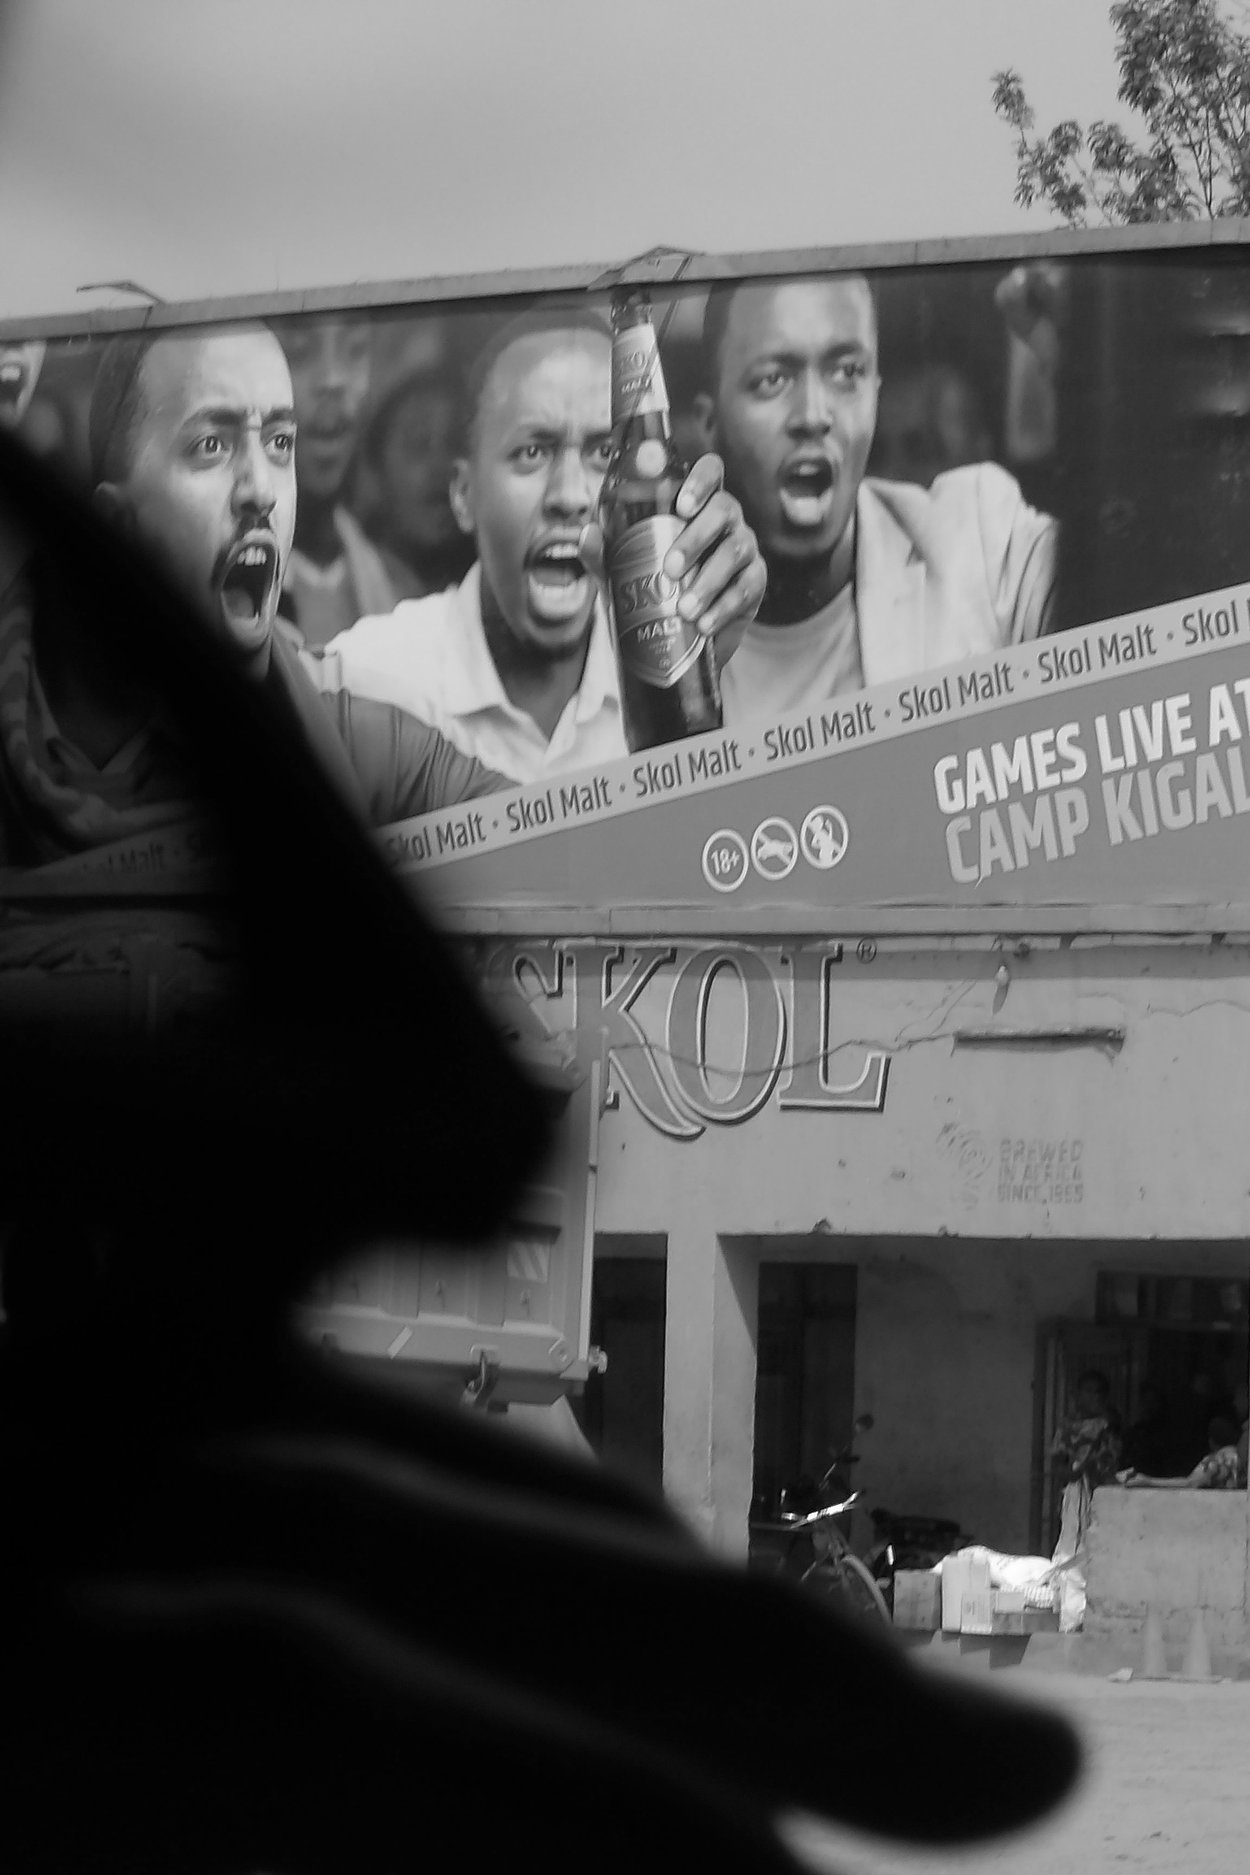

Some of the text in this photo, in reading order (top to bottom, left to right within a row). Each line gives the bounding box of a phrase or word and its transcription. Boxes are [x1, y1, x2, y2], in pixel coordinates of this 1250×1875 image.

[437, 812, 487, 856] Malt
[507, 790, 554, 834] Skol
[559, 777, 611, 820] Malt
[633, 754, 683, 798] Skol
[695, 739, 741, 782] Malt
[763, 718, 815, 761] Skol
[822, 702, 876, 745] Malt
[900, 677, 951, 722] Skol
[957, 663, 1014, 706] Malt
[1038, 639, 1092, 684] Skol
[1099, 625, 1157, 668] Malt
[1182, 600, 1239, 646] Skol
[933, 721, 1087, 815] GAMES
[1095, 693, 1198, 775] LIVE
[710, 845, 742, 876] 18+
[945, 785, 1090, 885] CAMP
